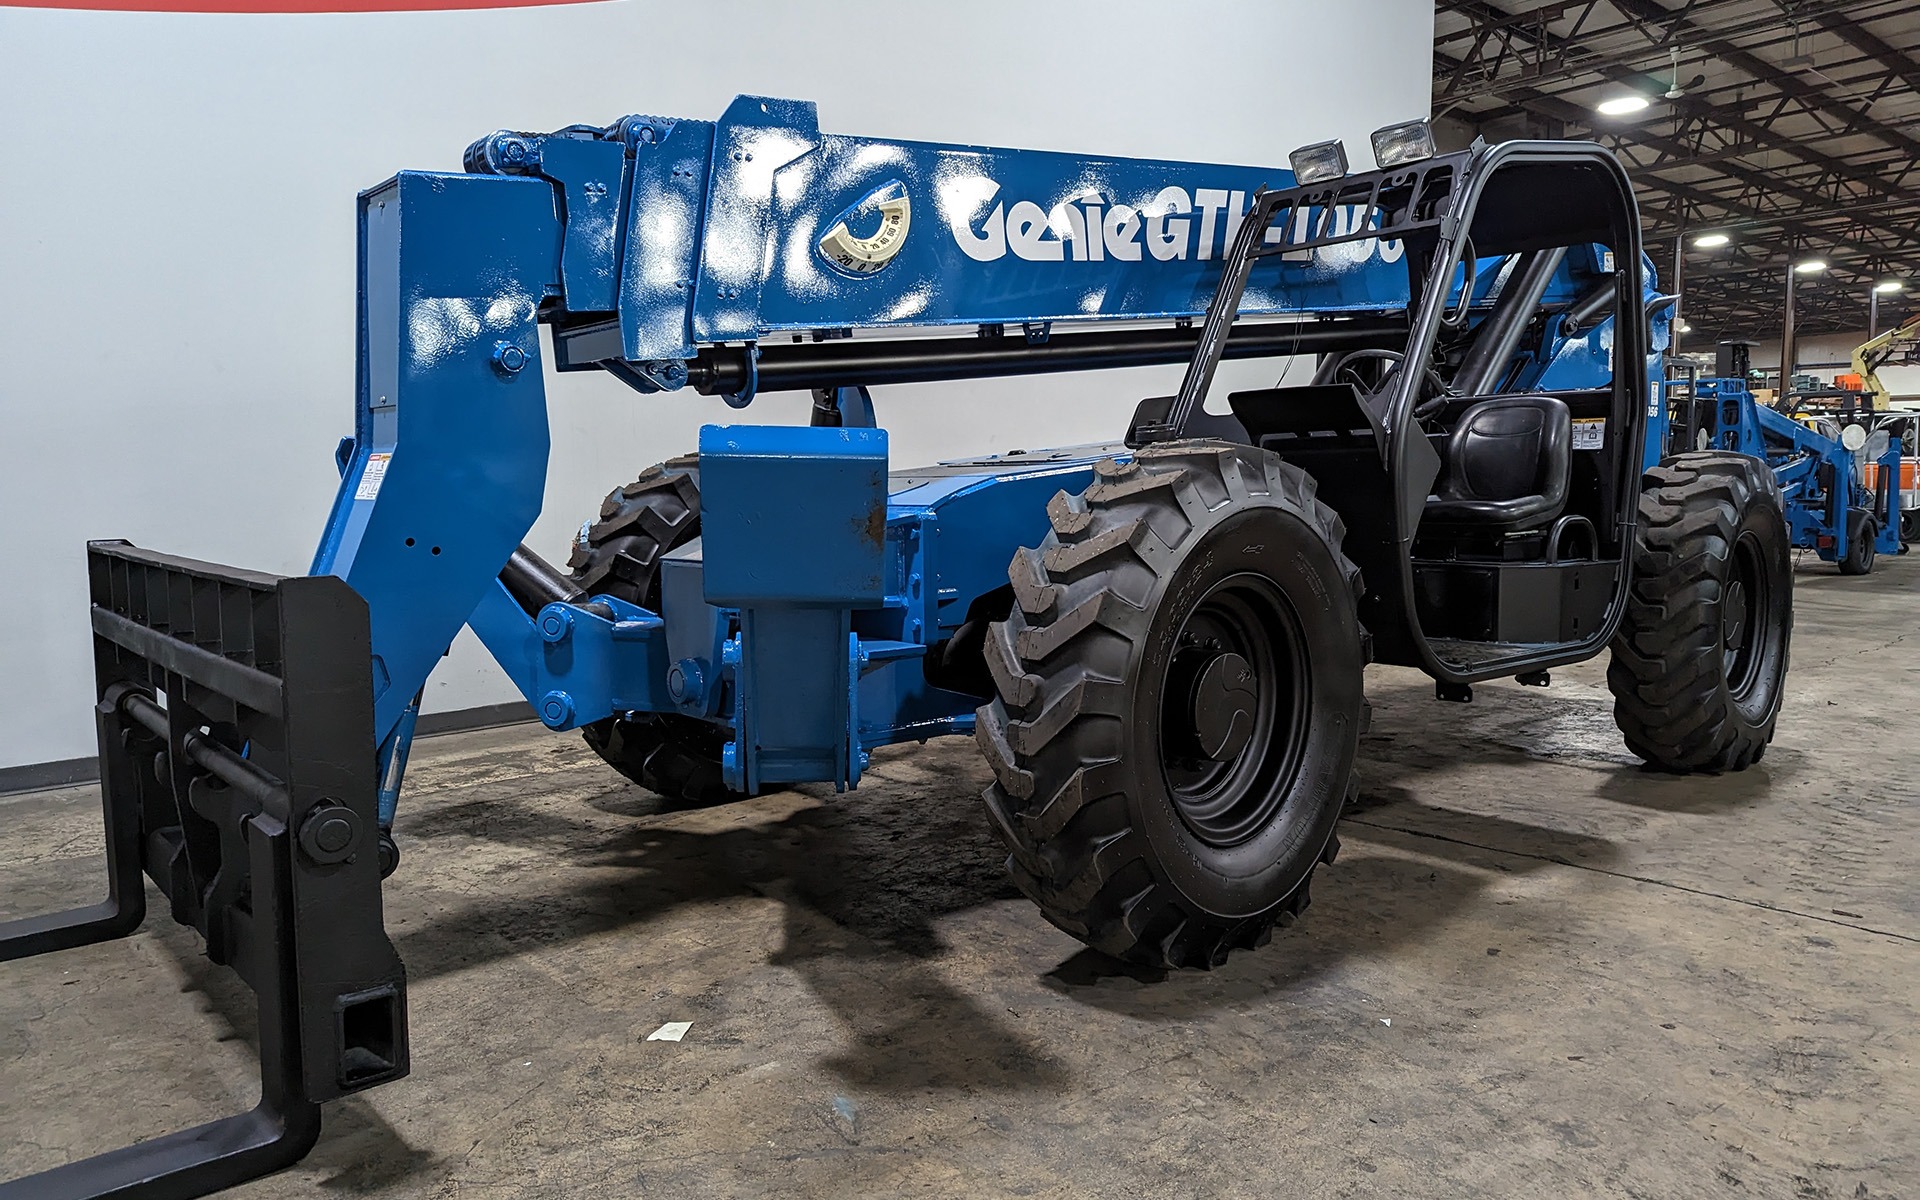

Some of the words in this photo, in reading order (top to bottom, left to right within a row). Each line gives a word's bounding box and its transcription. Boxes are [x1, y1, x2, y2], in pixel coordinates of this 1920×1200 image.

[891, 215, 900, 225] 80
[949, 177, 1142, 262] Genie
[887, 227, 897, 237] 60
[880, 237, 890, 245] 40
[837, 254, 853, 266] -20
[857, 263, 866, 271] 0
